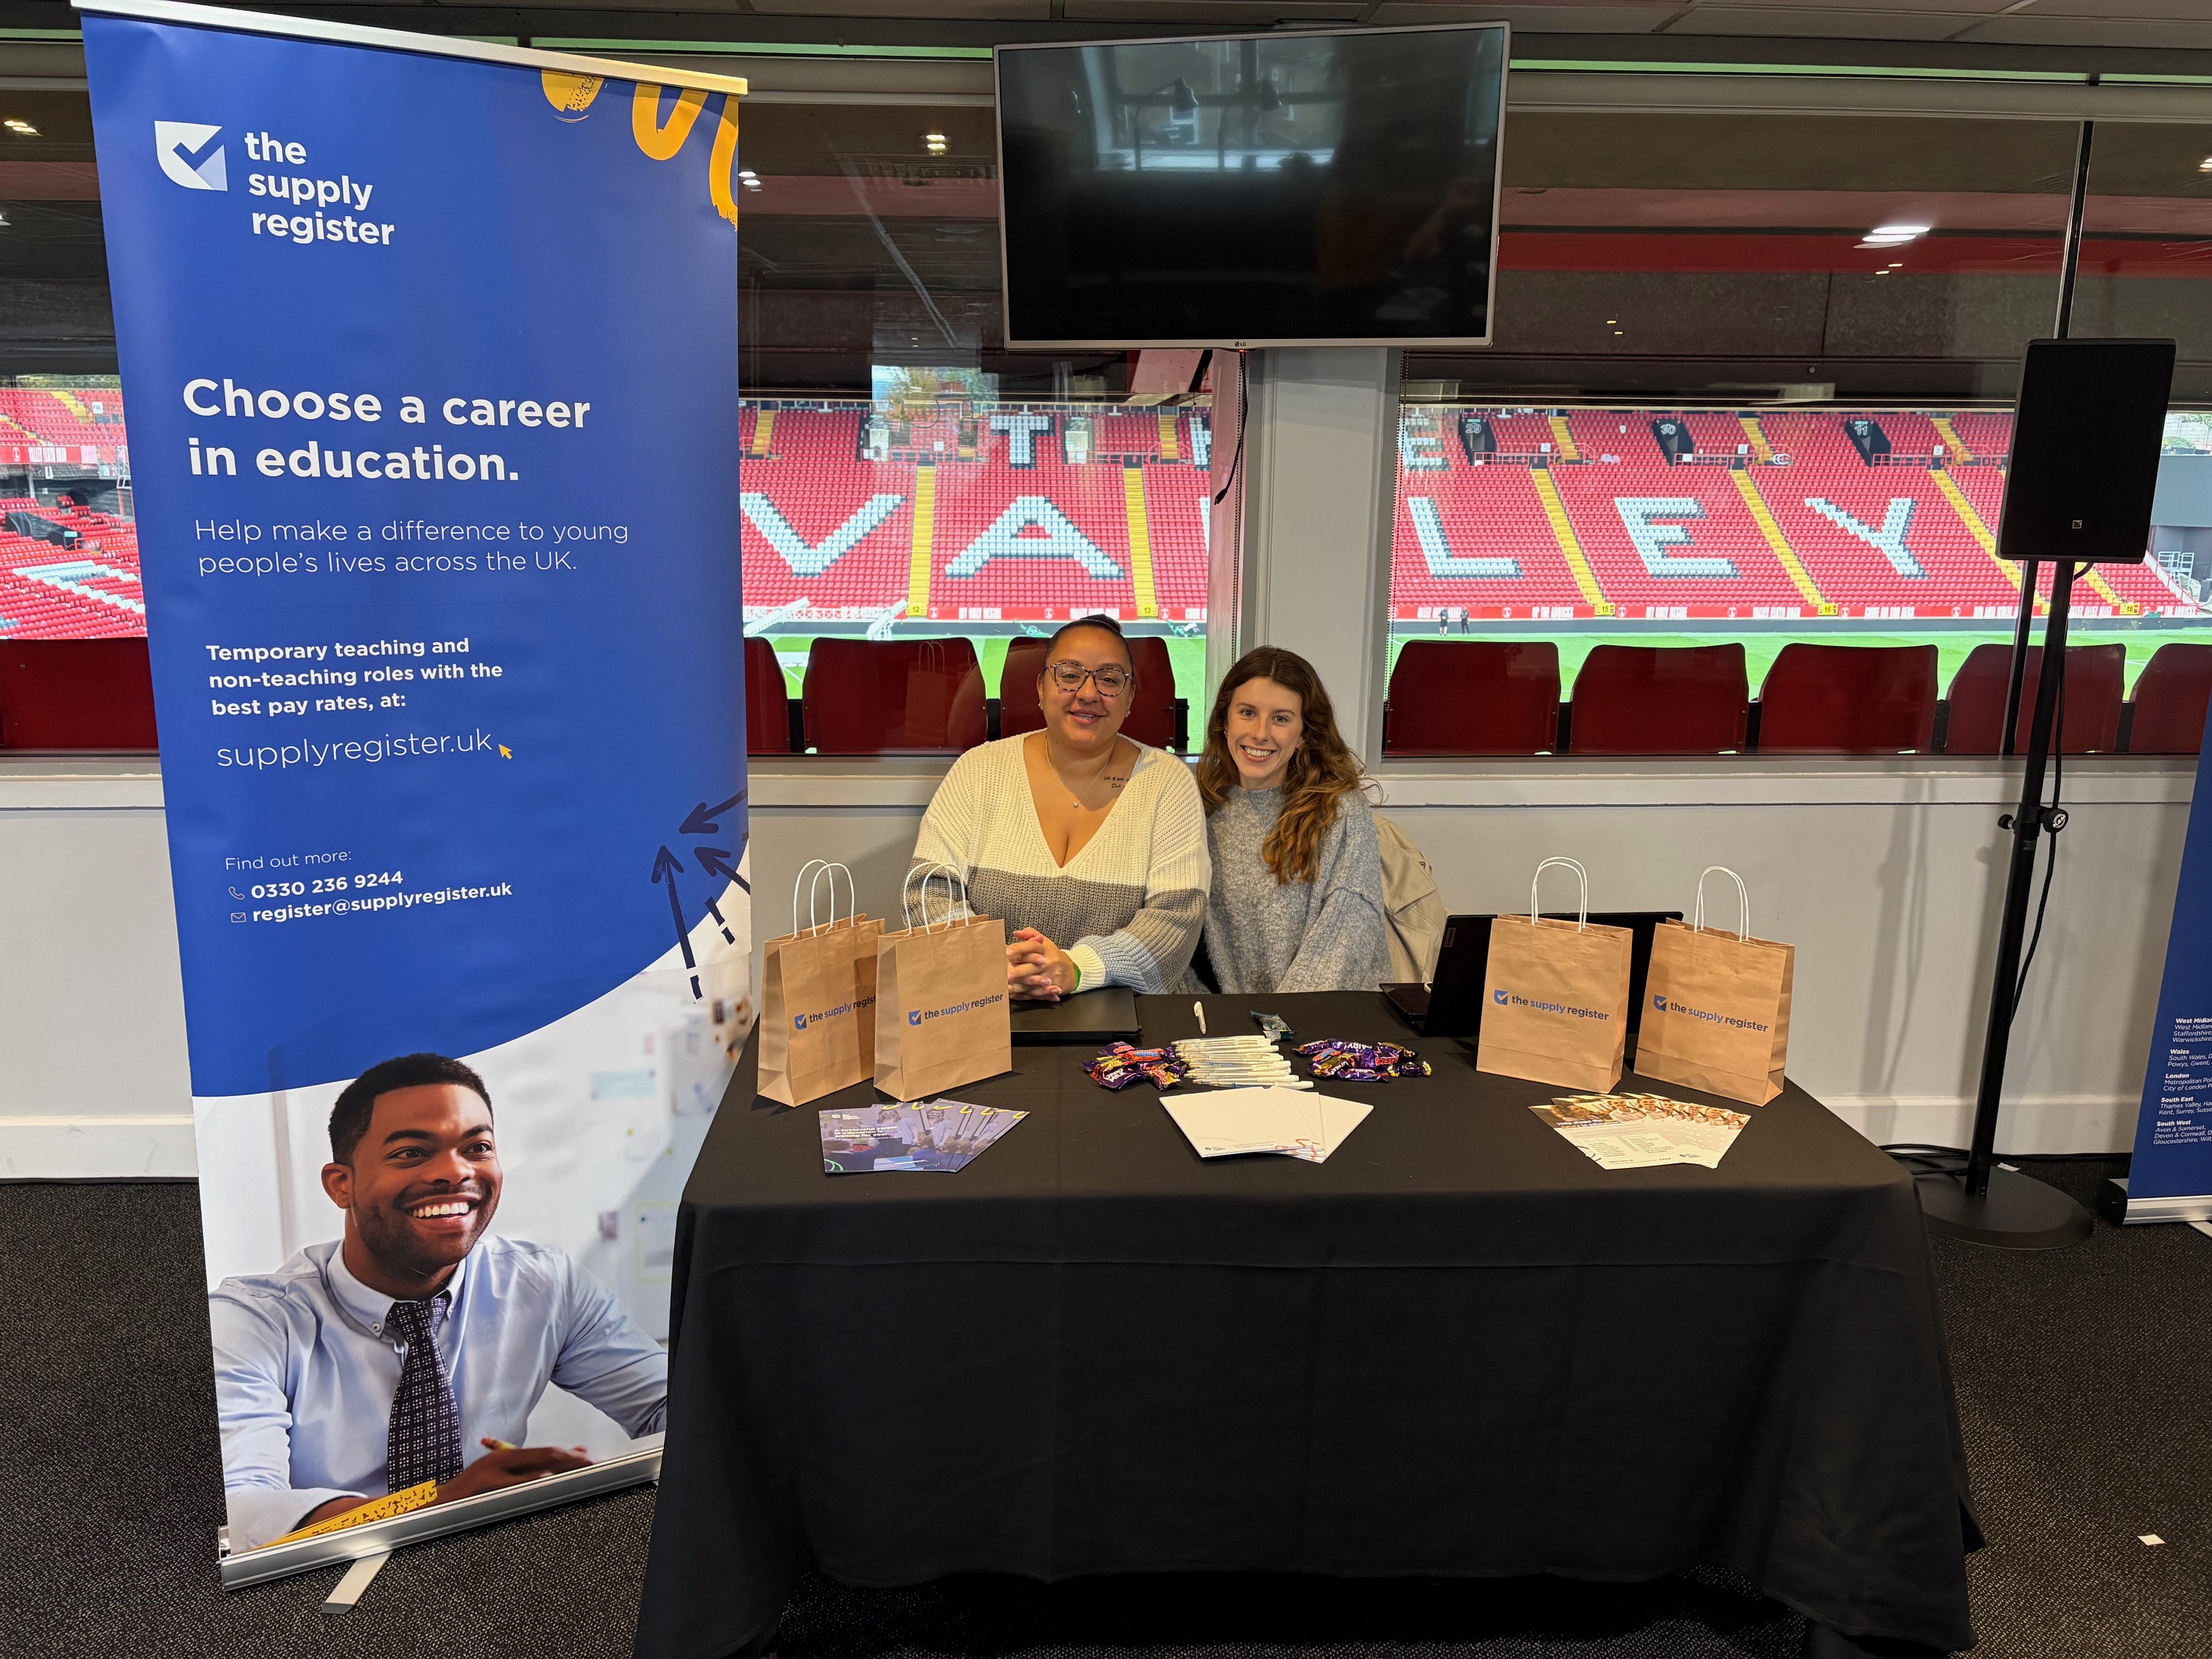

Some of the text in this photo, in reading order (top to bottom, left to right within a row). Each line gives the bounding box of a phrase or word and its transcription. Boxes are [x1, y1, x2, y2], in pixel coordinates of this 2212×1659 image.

[244, 131, 307, 165] the
[248, 173, 373, 211] supply
[252, 211, 395, 246] register
[183, 378, 591, 428] Choose a career
[1465, 423, 1482, 434] 29
[1660, 423, 1676, 435] 30
[188, 437, 519, 481] in education.
[195, 519, 628, 544] Help make a difference to young
[199, 550, 576, 577] people’s lives across the UK.
[205, 637, 469, 663] Temporary teaching and
[209, 662, 503, 689] non-teaching roles with the
[211, 692, 406, 717] best pay rates, at:
[217, 728, 493, 771] supplyregister.uk
[225, 851, 352, 871] Find out more:
[251, 871, 404, 899] 0330 236 9244
[252, 882, 513, 922] register@supplyregister.uk
[809, 1012, 823, 1023] the
[824, 1003, 852, 1020] supply
[924, 992, 1004, 1020] the supply register
[1512, 995, 1609, 1022] the supply register
[1670, 1001, 1769, 1032] the supply register
